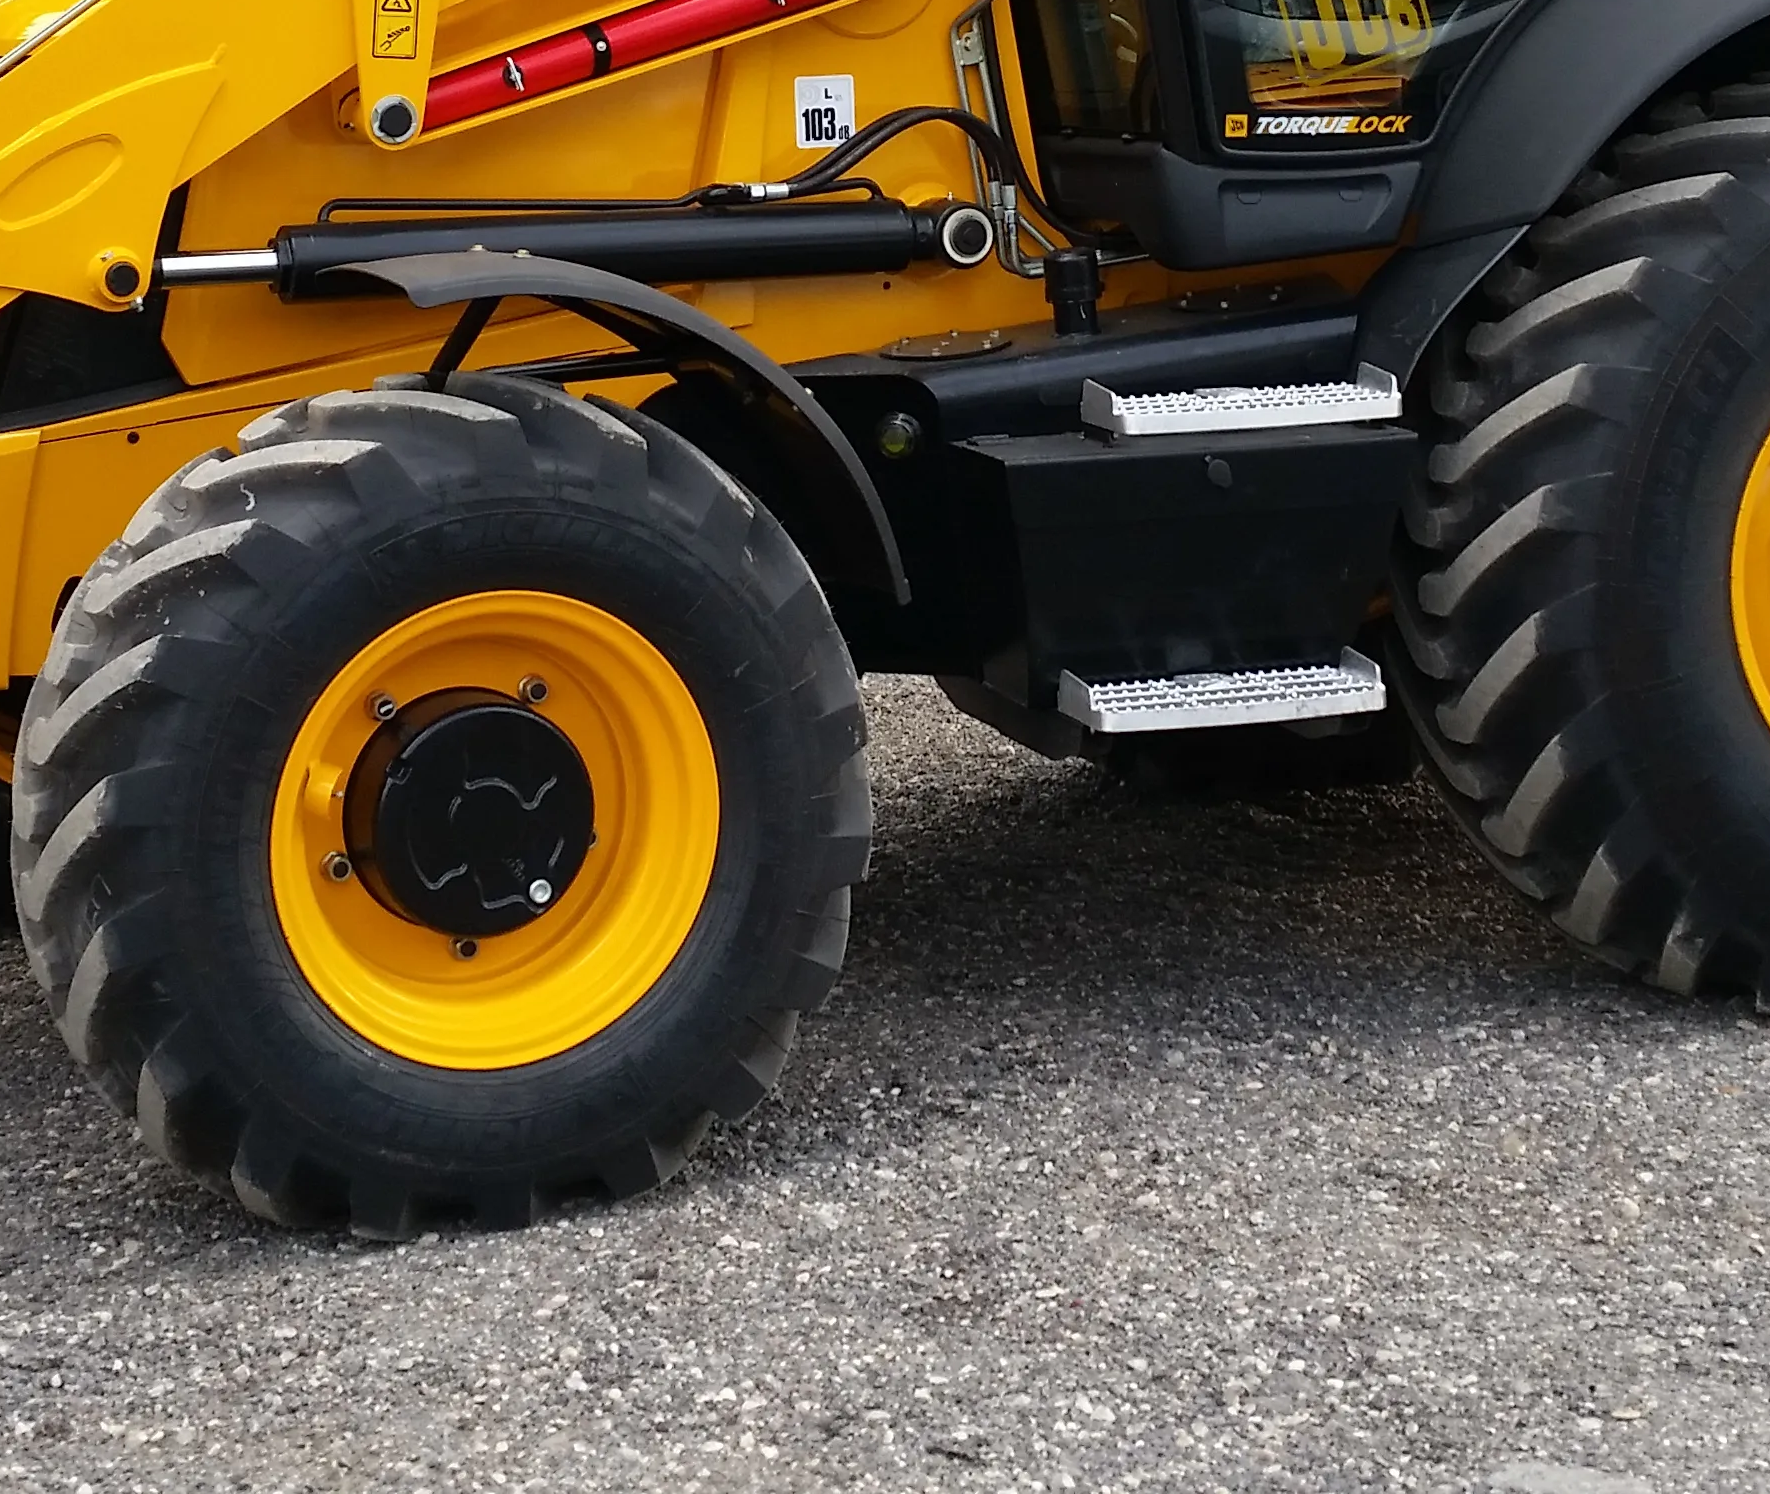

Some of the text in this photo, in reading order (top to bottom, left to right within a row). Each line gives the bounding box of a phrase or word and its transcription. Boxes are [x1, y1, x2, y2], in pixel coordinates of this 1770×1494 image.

[824, 87, 833, 99] L
[801, 107, 850, 142] 103 dB
[1254, 115, 1413, 136] TORQUELOCK
